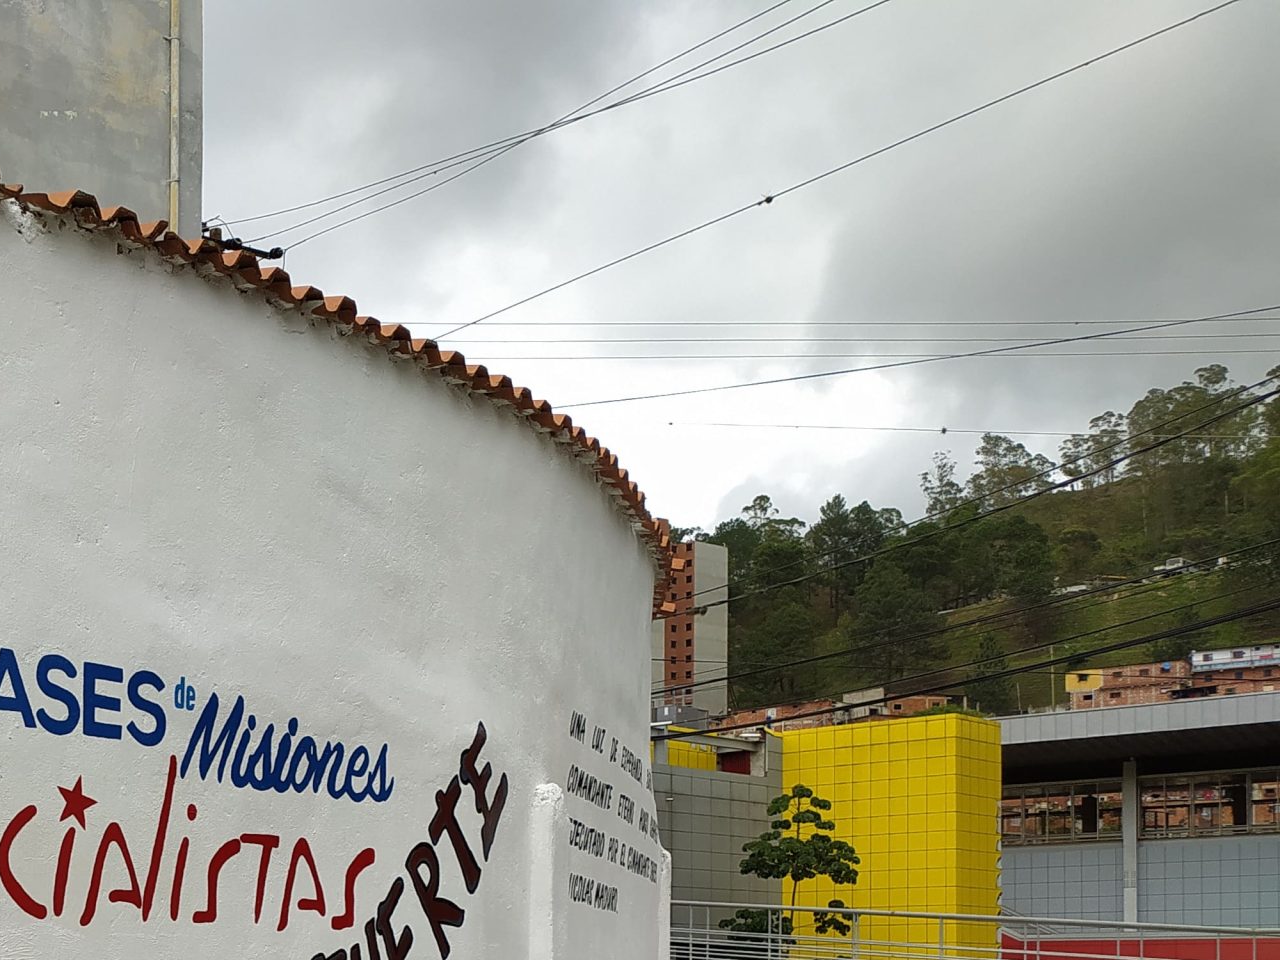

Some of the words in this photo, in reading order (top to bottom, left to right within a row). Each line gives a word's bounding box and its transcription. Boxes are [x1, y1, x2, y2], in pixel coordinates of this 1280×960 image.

[174, 676, 196, 711] de
[180, 692, 395, 802] Misiones
[569, 710, 587, 744] UNA
[591, 726, 606, 754] LUZ
[567, 764, 613, 809] COMANDANTE
